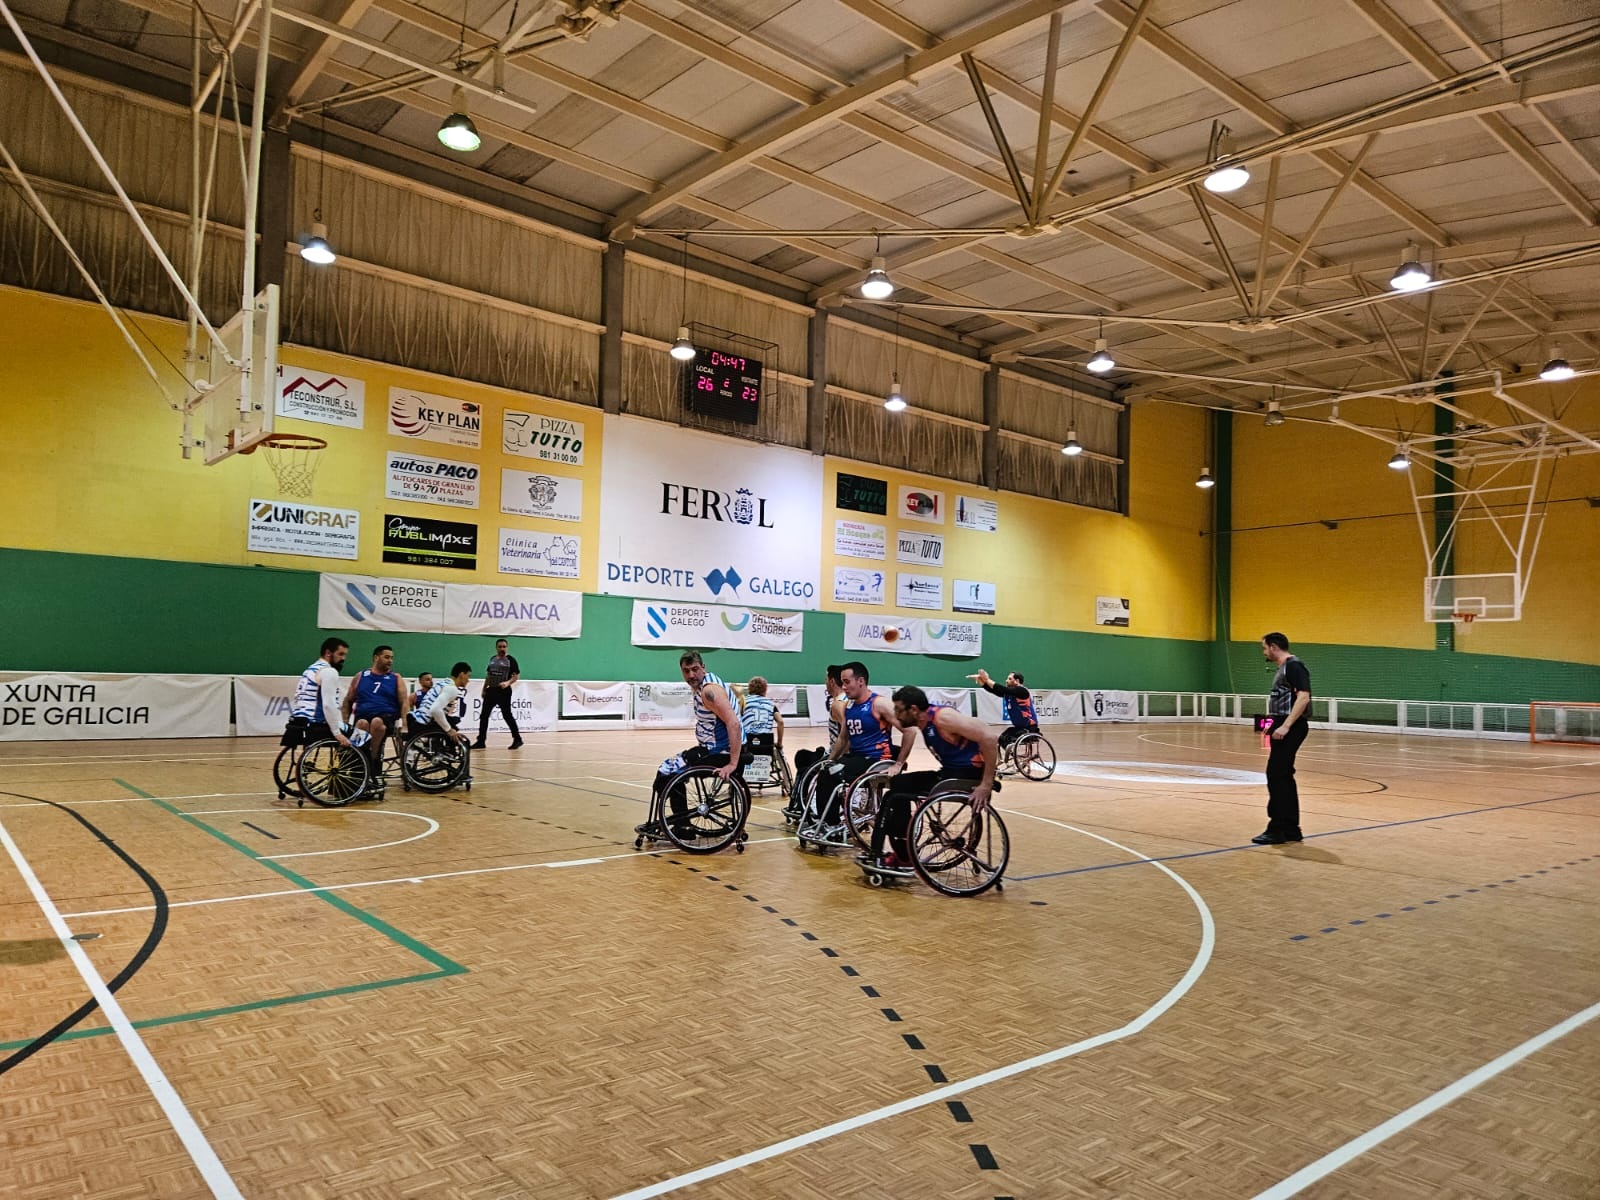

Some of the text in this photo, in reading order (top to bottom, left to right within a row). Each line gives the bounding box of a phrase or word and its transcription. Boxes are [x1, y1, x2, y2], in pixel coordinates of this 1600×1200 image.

[711, 352, 746, 371] 04:47
[695, 365, 714, 374] LOCAL
[697, 375, 714, 391] 26
[742, 386, 758, 402] 23
[418, 407, 480, 430] KEY PLAN
[540, 418, 576, 435] PIZZA
[530, 431, 582, 453] TUTTO
[553, 452, 560, 460] 31
[569, 455, 578, 463] 00
[390, 460, 478, 480] autos PACO
[413, 483, 420, 491] 9
[425, 485, 438, 494] 70
[439, 487, 464, 496] PLAZAS
[441, 481, 460, 489] GRAN
[273, 506, 357, 529] UNIGRAF
[388, 528, 474, 550] PUBLIMAXE
[501, 547, 541, 559] Veterinaria
[899, 539, 916, 554] PIZZA
[921, 539, 942, 560] TUTTO
[607, 562, 814, 598] DEPORTE GALEGO
[381, 585, 438, 598] DEPORTE
[381, 597, 432, 608] GALEGO
[671, 608, 709, 618] DEPORTE
[752, 614, 784, 625] GALICIA
[670, 617, 705, 627] GALEGO
[948, 624, 972, 633] GALICIA
[752, 624, 793, 636] SAUDABLE
[948, 632, 979, 643] SAUDABLE
[5, 684, 96, 702] XUNTA
[372, 681, 381, 693] 7
[3, 706, 150, 726] DE GALICIA
[846, 718, 863, 736] 32
